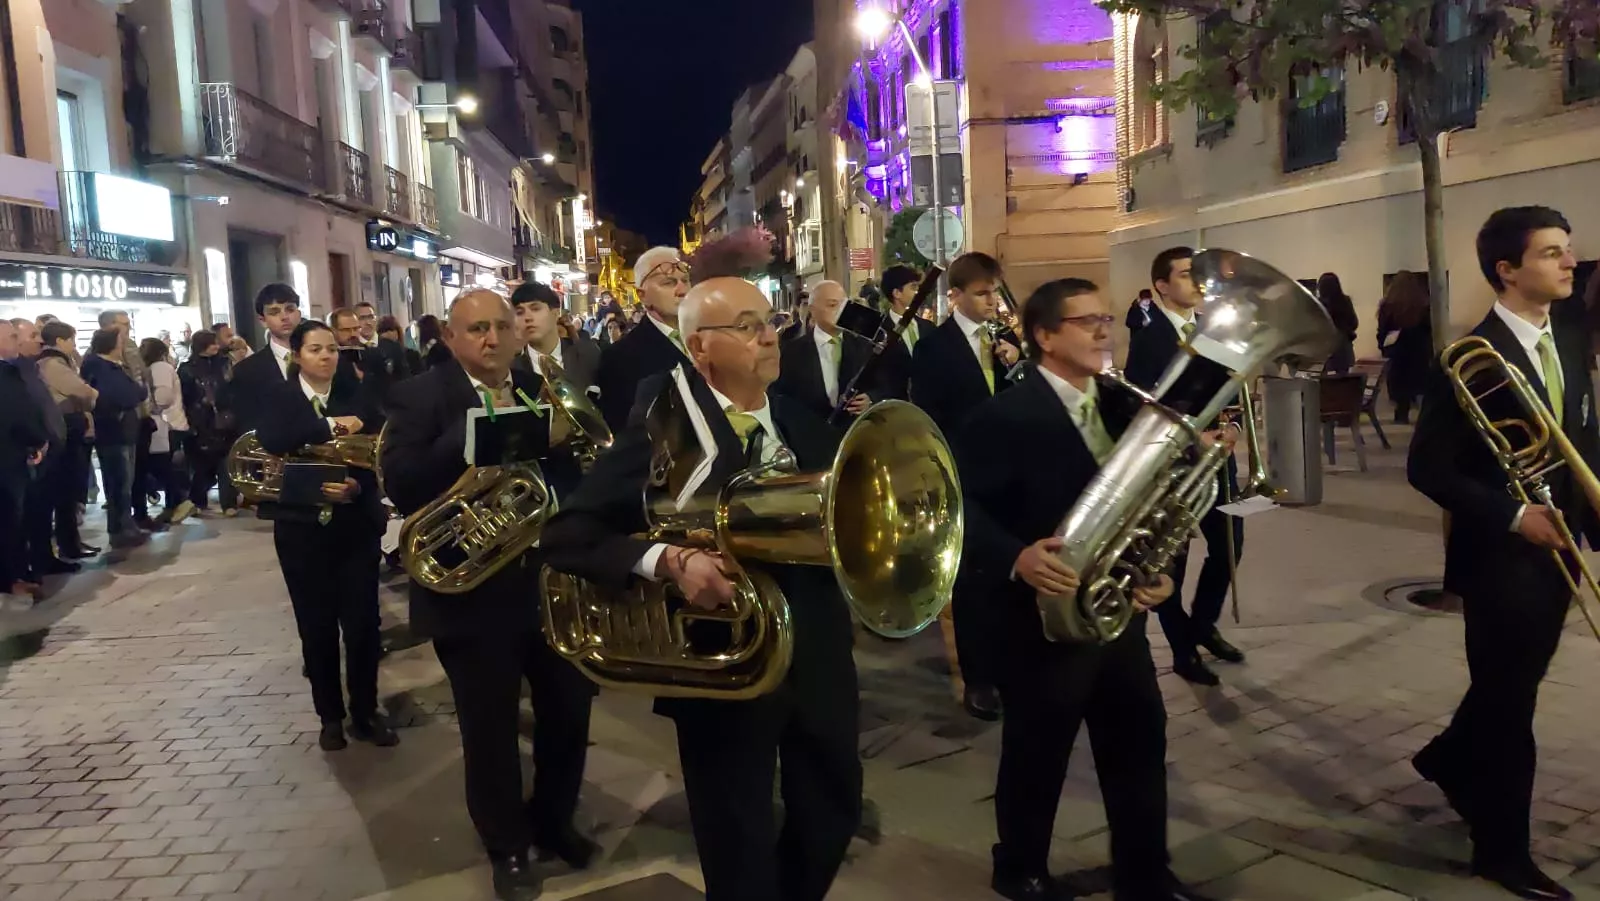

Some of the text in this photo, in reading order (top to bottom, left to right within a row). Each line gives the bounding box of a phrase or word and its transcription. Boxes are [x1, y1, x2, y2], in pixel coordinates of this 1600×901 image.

[380, 233, 396, 245] IN
[25, 271, 127, 300] EL FOSKO
